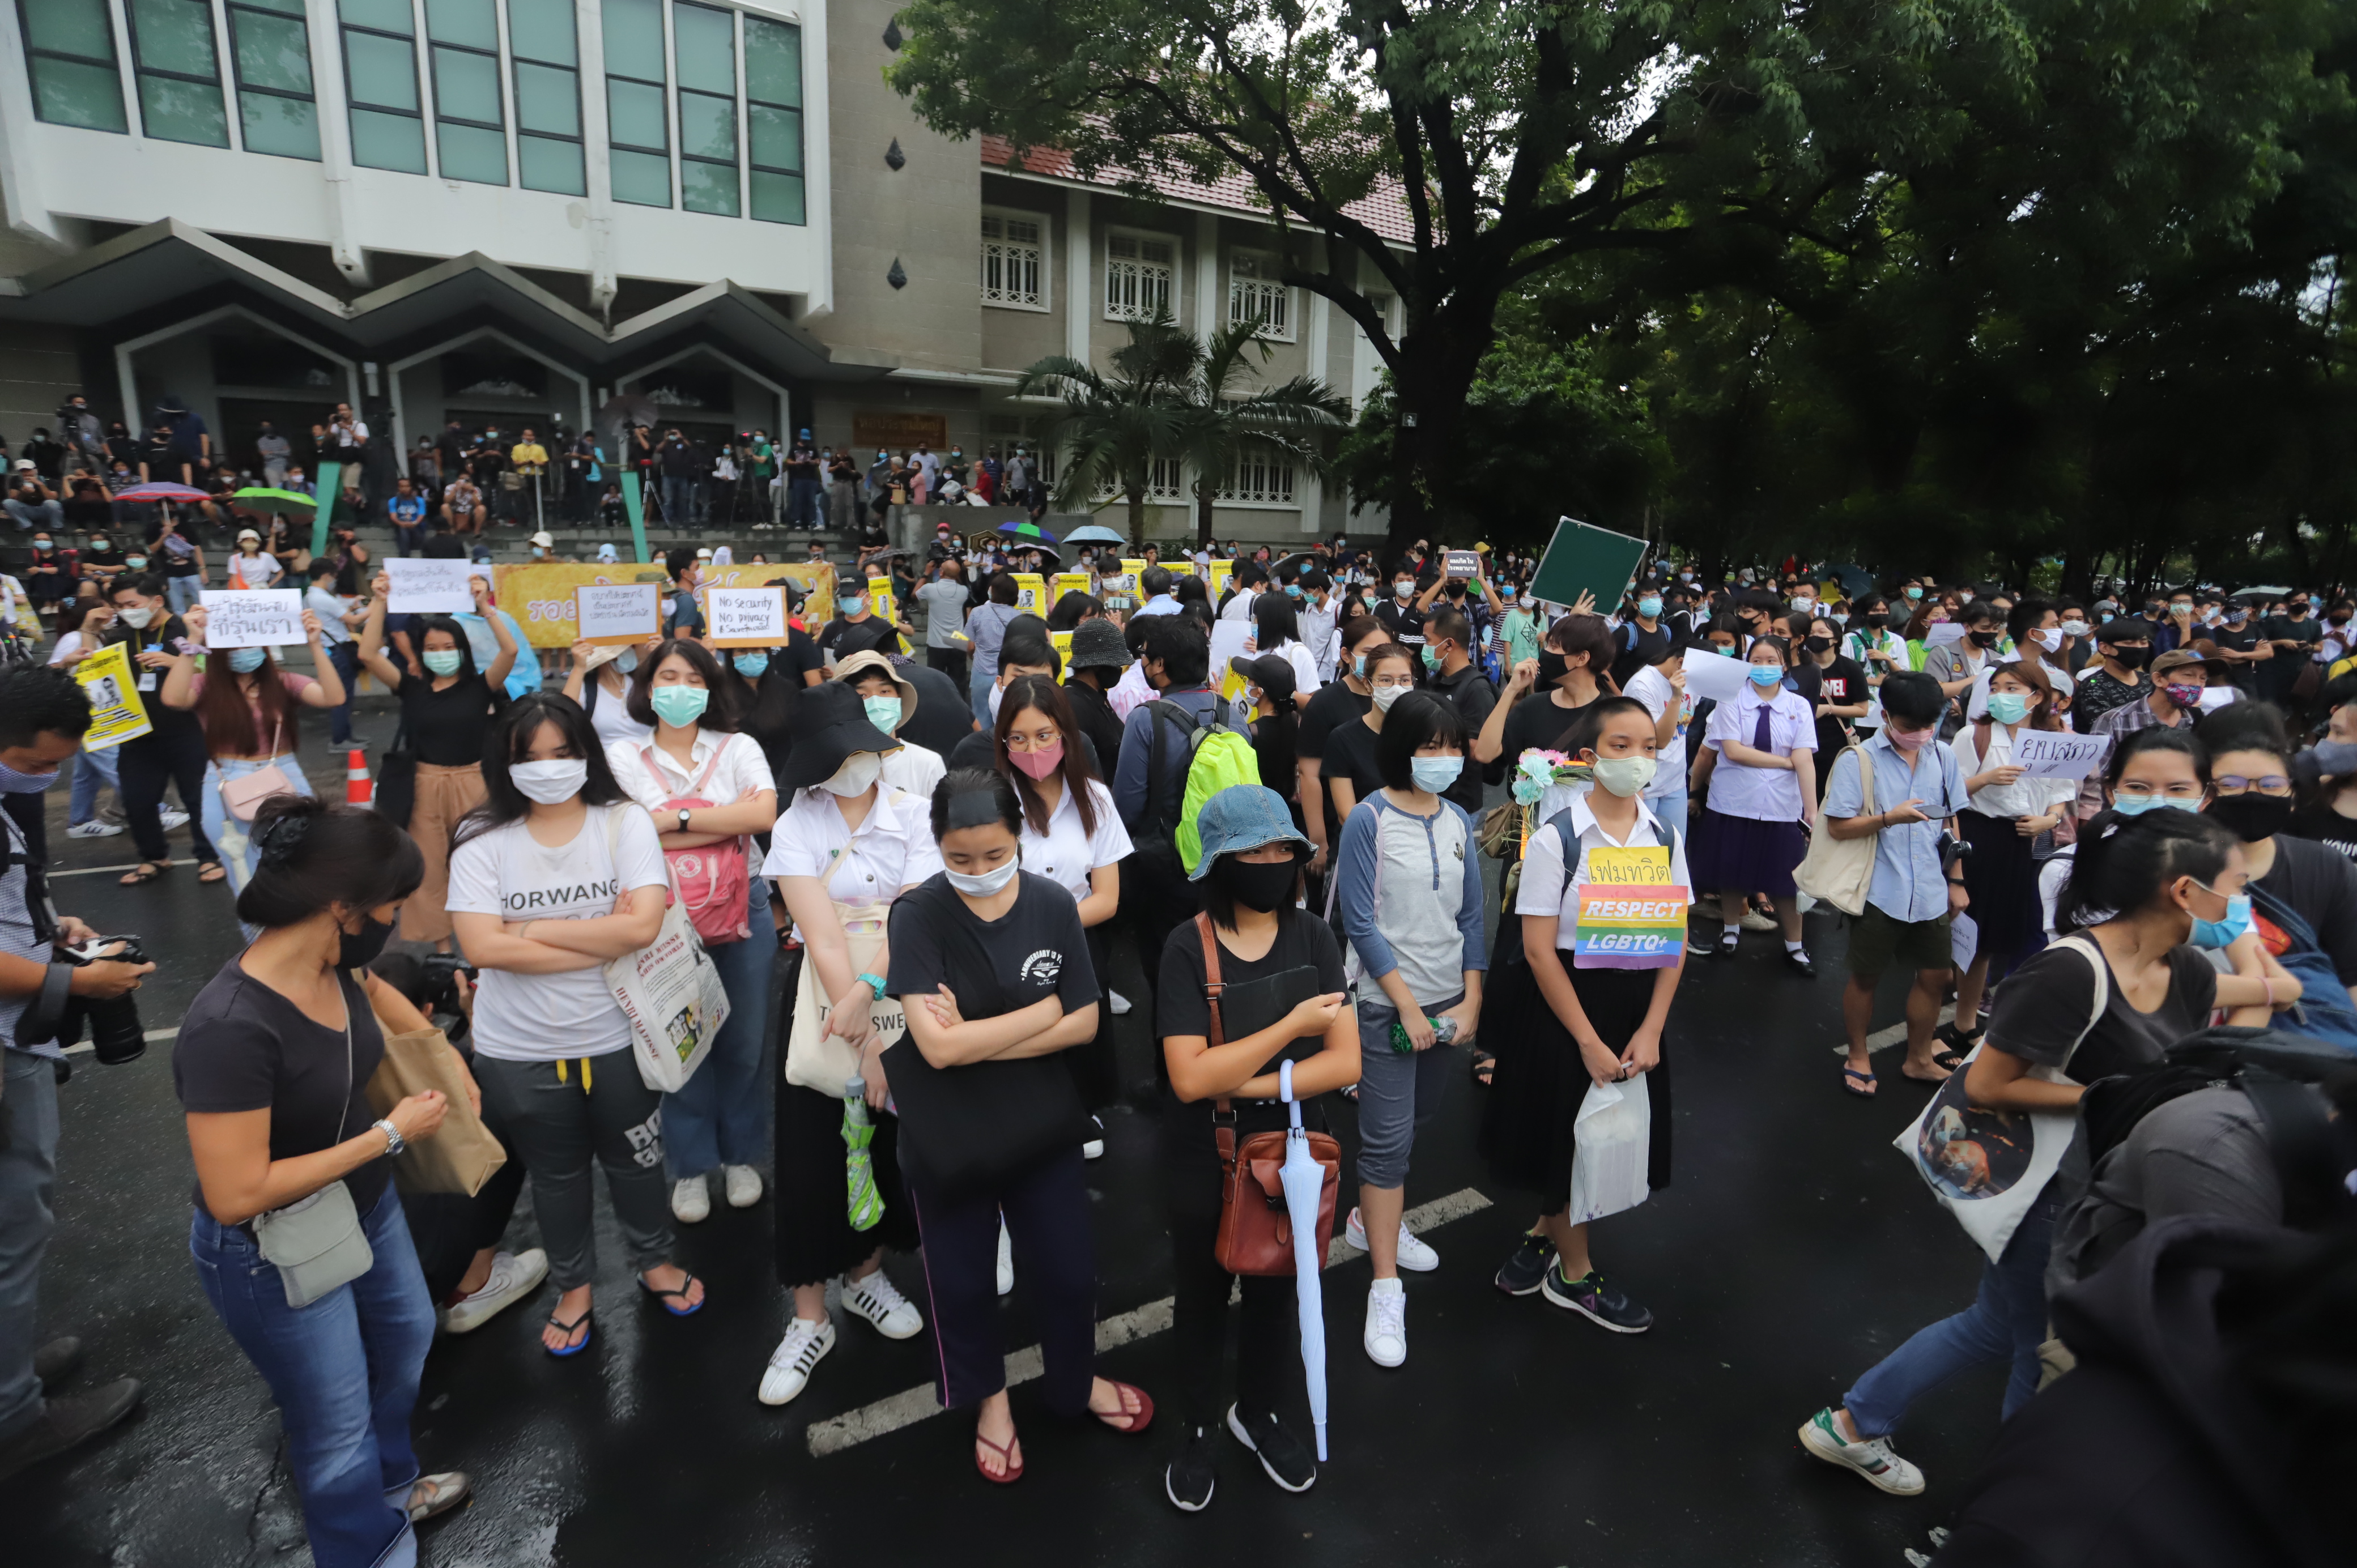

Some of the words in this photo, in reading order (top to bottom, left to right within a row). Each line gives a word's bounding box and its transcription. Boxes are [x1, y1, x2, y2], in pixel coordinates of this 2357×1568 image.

[719, 597, 731, 607] No
[735, 596, 772, 611] security
[719, 612, 733, 623] No
[739, 612, 770, 626] privacy
[2021, 737, 2099, 772] ยุบสภา
[1589, 857, 1670, 883] เฟมทวิต
[1585, 901, 1683, 918] RESPECT
[1586, 934, 1669, 952] LGBTQ+
[1020, 949, 1050, 977] ANNIVERSARY
[615, 987, 637, 1019] HENRI
